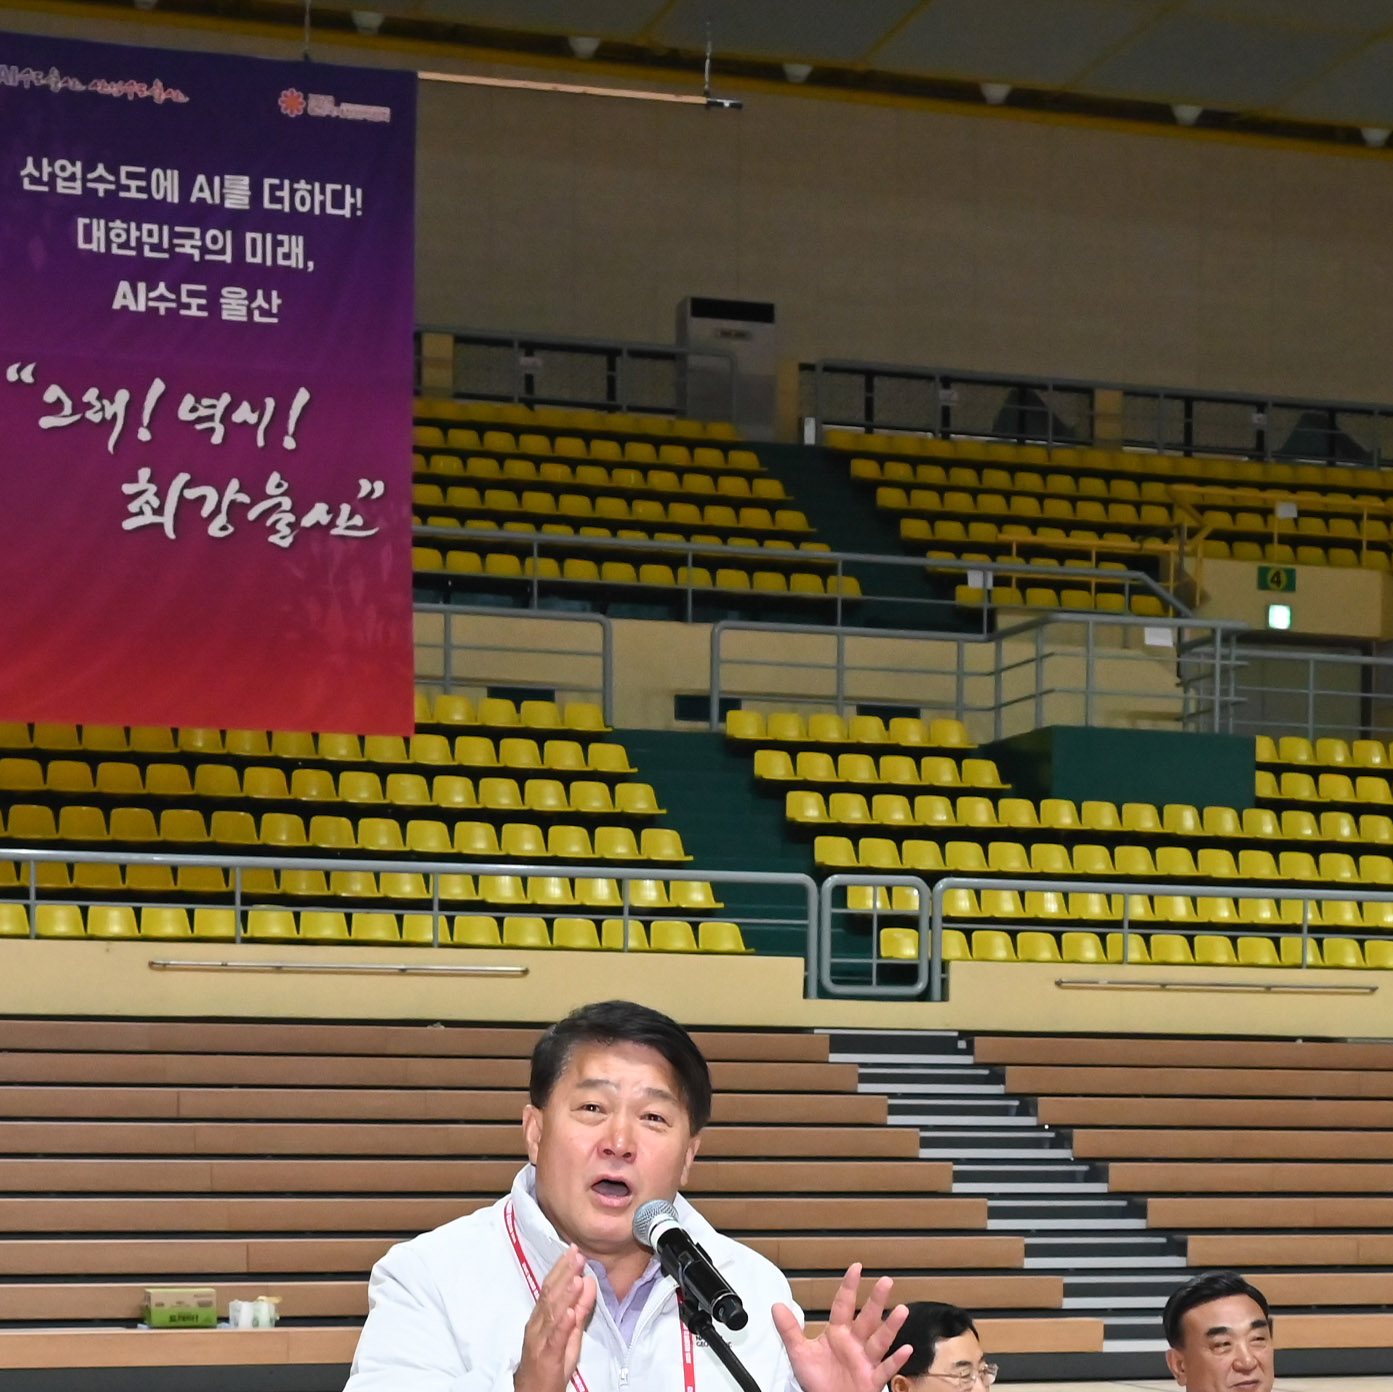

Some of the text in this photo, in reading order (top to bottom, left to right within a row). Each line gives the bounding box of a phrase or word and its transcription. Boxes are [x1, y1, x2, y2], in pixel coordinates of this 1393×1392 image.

[19, 155, 363, 218] 산업수도에 AI를 더하다!
[76, 216, 315, 272] 대한민국의 미래,
[112, 280, 282, 324] AI수도 울산
[177, 386, 311, 450] 역시!
[1271, 570, 1282, 589] 4
